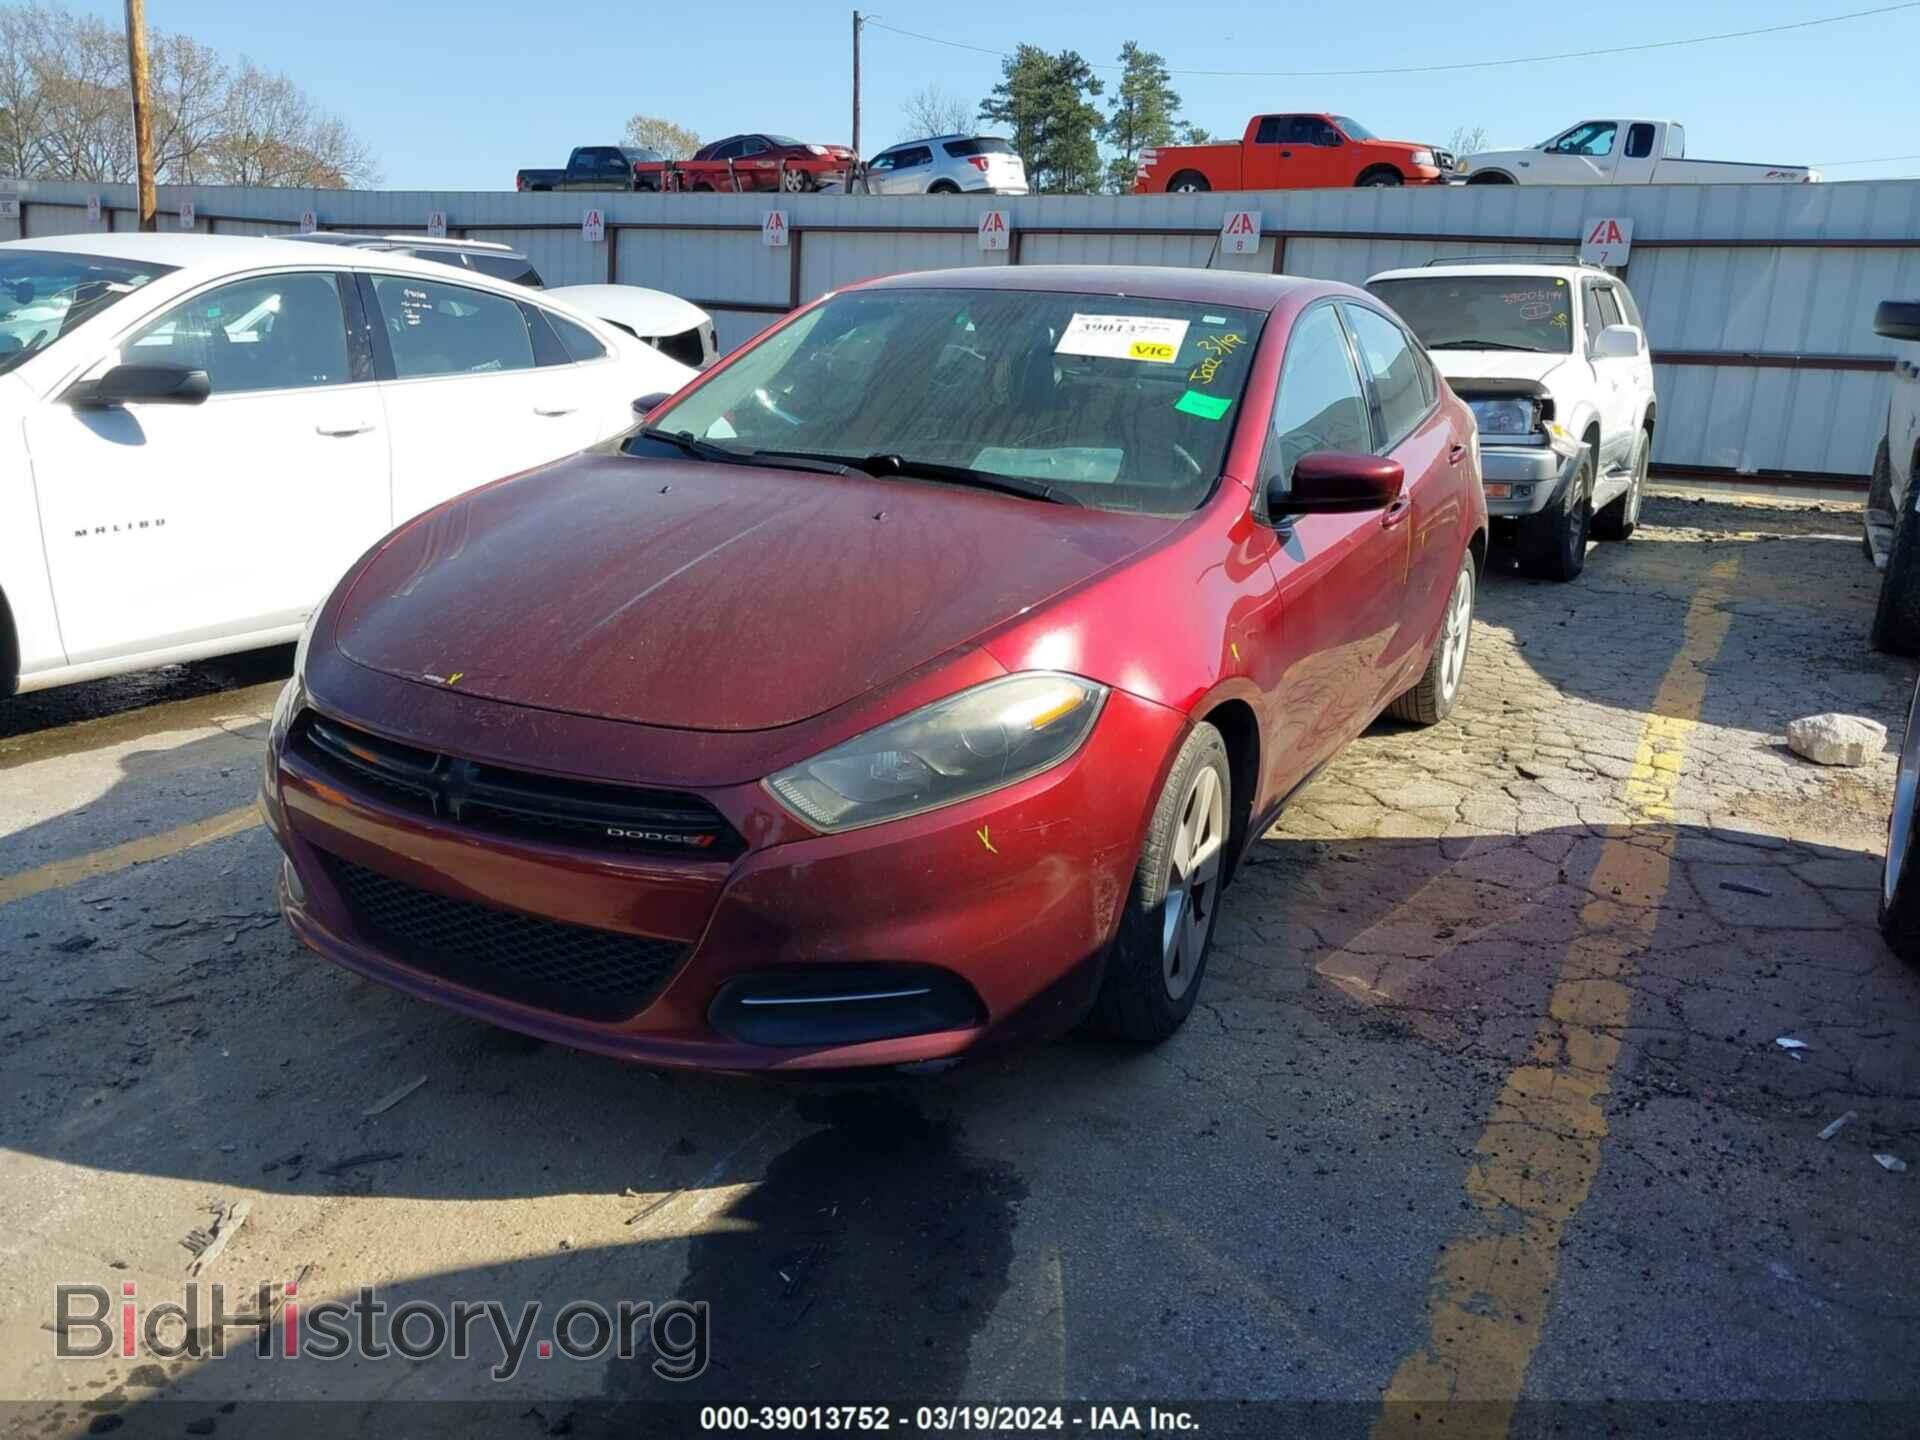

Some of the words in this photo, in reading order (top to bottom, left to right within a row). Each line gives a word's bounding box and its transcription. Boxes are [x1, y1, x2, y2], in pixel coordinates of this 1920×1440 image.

[1588, 220, 1624, 245] IAA
[990, 238, 998, 248] 9
[1600, 250, 1609, 263] 7
[1082, 321, 1171, 334] 390137
[1134, 344, 1173, 358] VIC
[74, 518, 166, 538] MALIBU
[607, 828, 700, 845] DODGE
